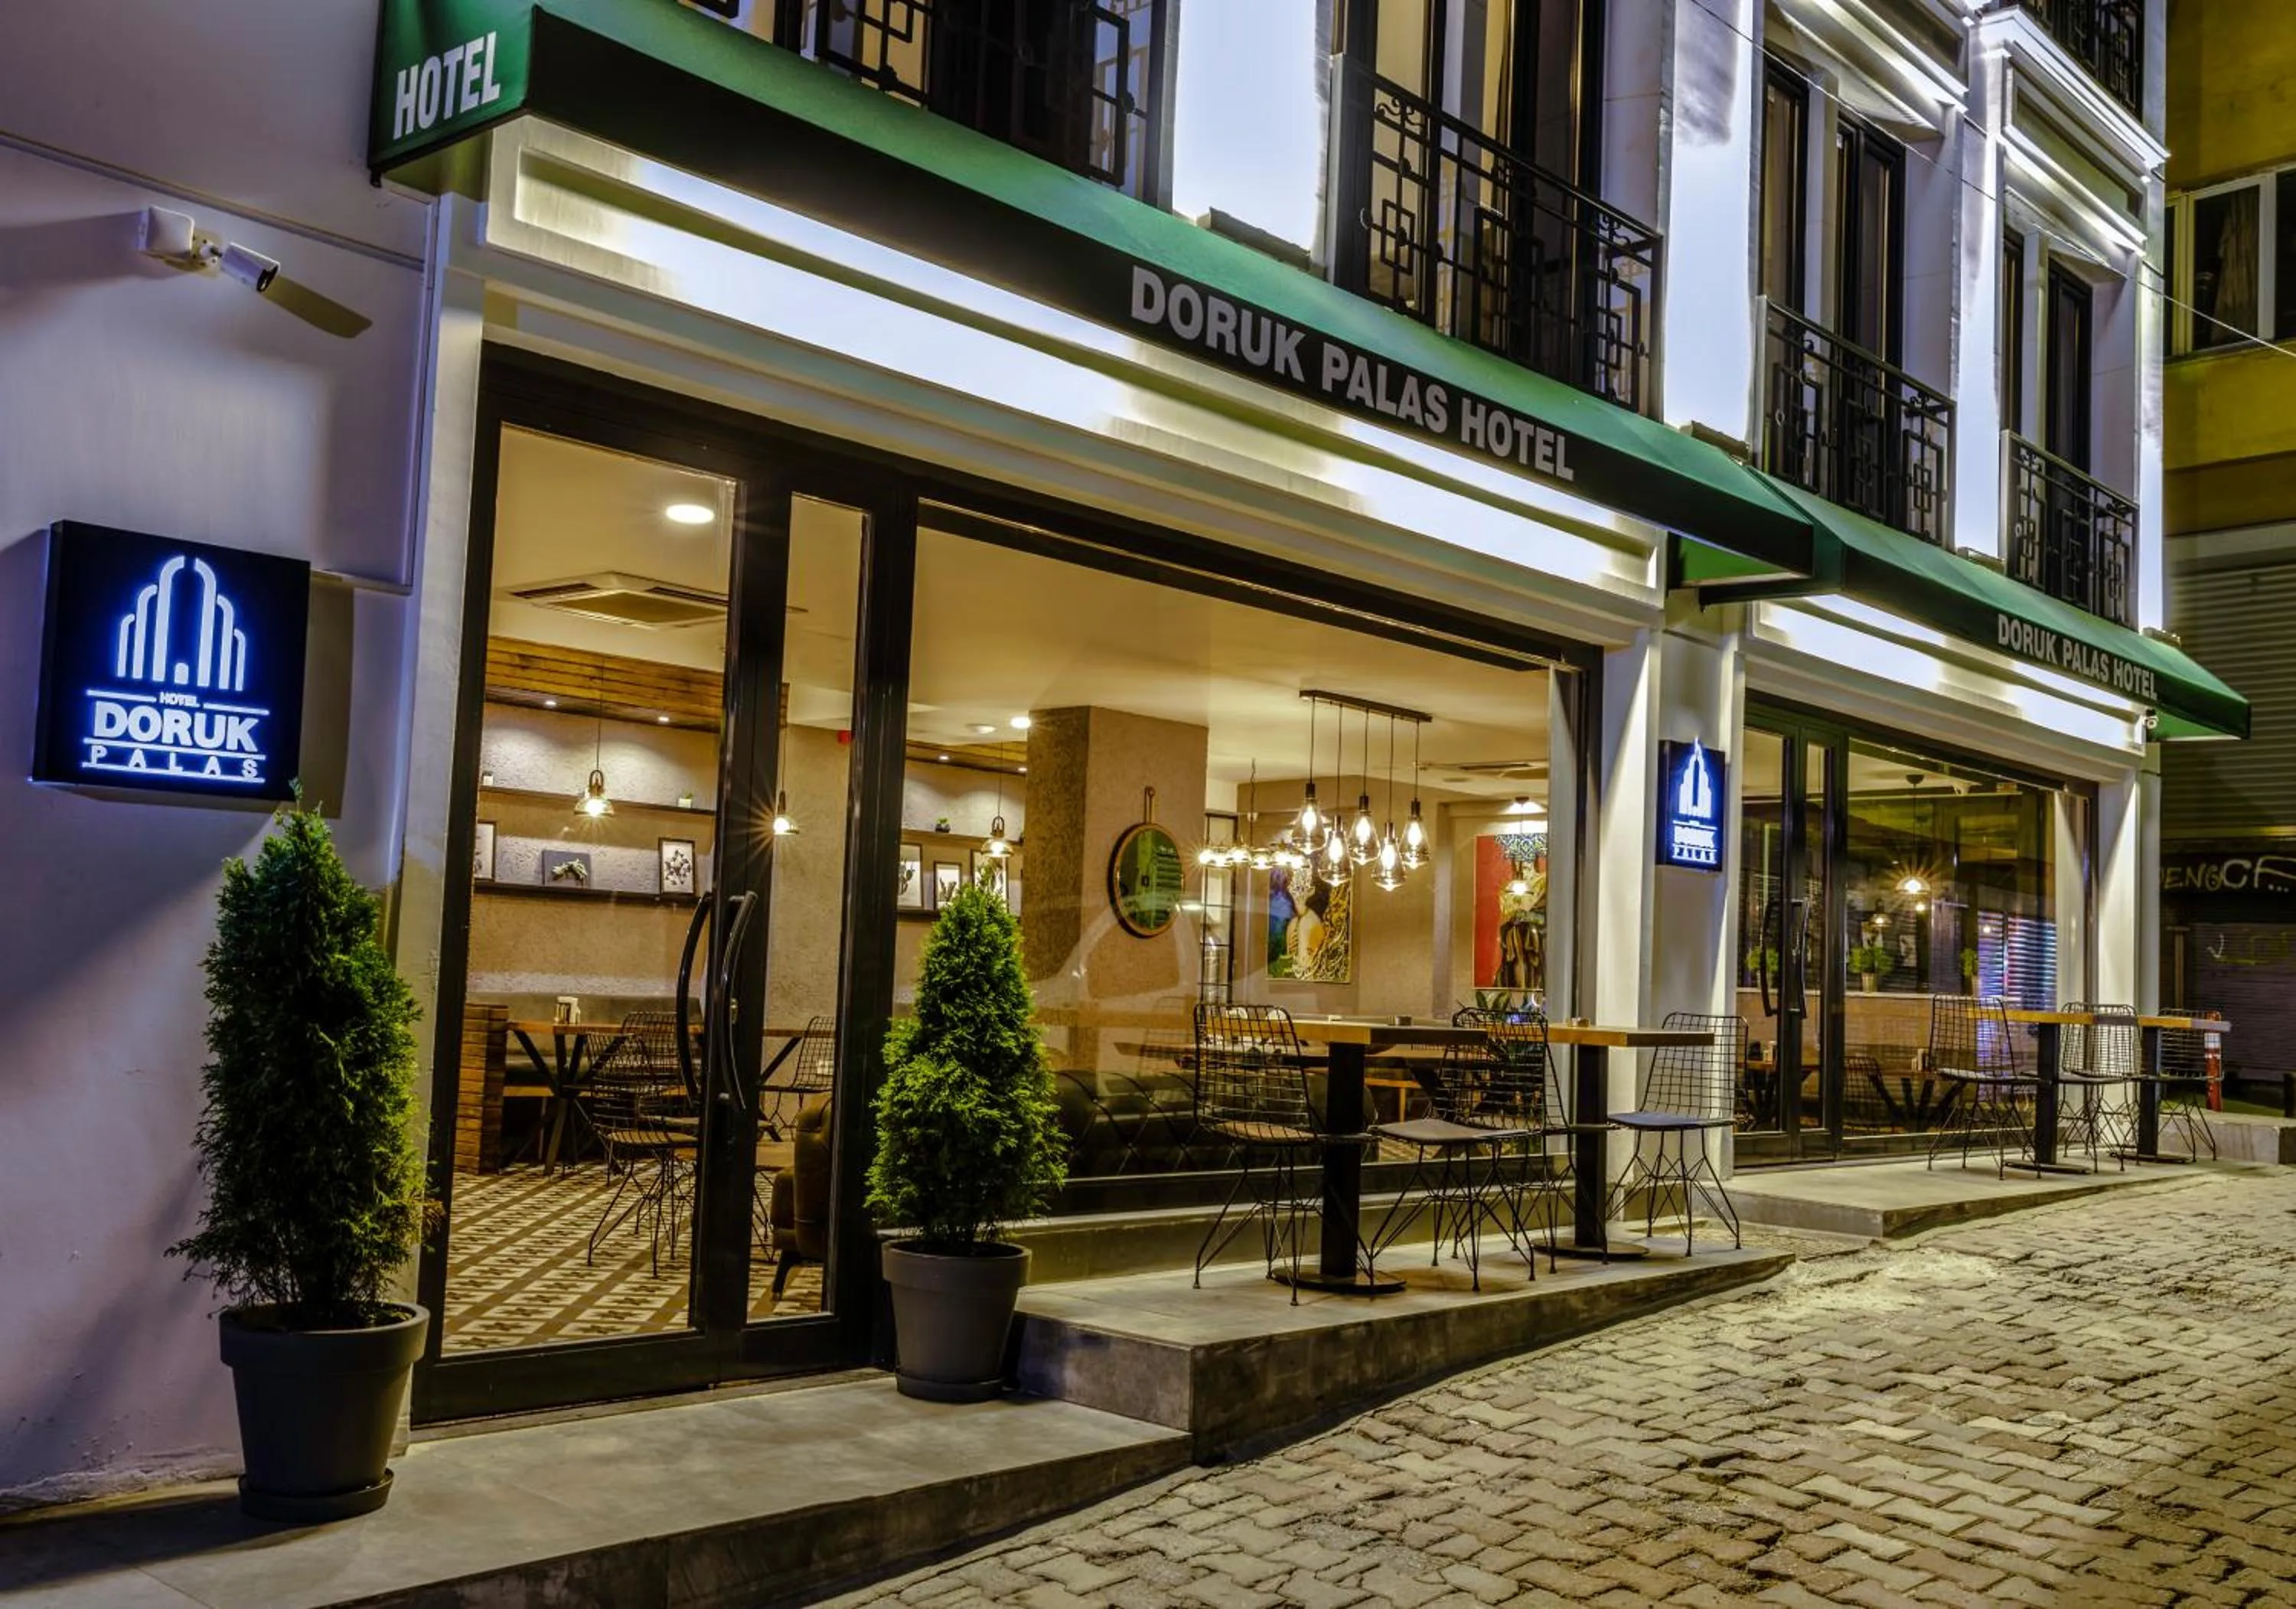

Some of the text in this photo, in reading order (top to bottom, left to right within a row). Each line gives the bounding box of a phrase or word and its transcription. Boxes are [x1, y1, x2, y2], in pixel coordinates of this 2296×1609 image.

[393, 31, 501, 140] HOTEL
[1130, 265, 1574, 481] DORUK PALAS HOTEL
[1998, 613, 2158, 701] DORUK PALAS HOTEL
[93, 700, 259, 752] DORUK
[159, 691, 200, 708] HOTEL
[90, 745, 259, 778] PALAS
